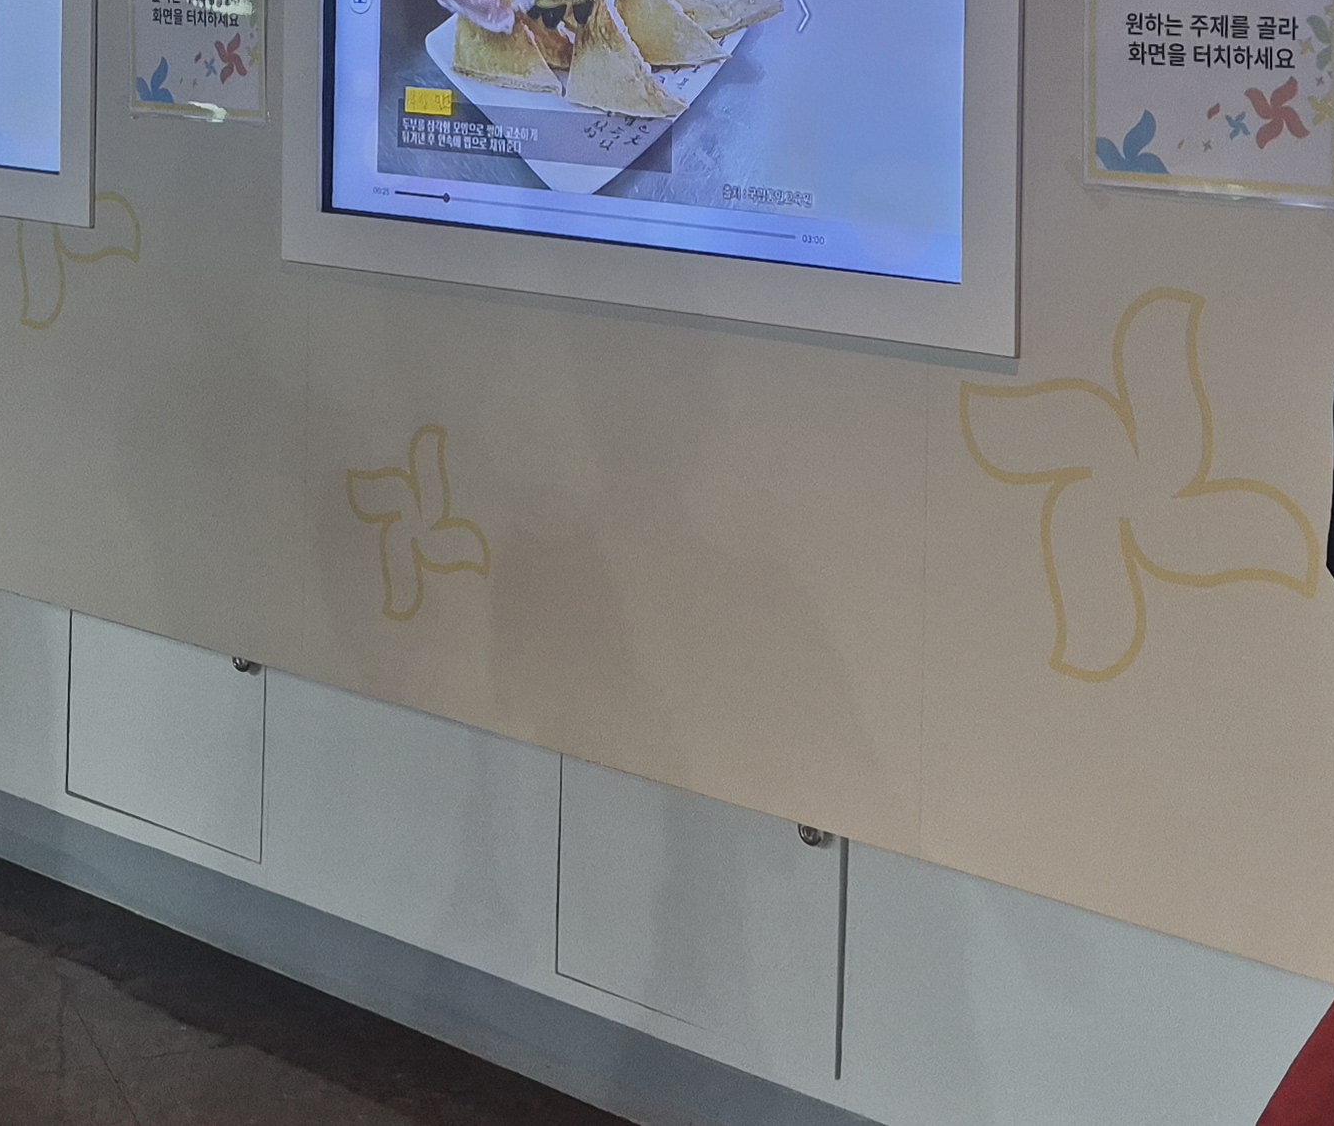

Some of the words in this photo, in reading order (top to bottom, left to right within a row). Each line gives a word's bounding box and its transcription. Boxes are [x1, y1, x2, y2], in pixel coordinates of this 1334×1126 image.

[152, 7, 183, 26] 화면을
[186, 10, 240, 28] 터치하세요
[1125, 12, 1184, 37] 원하는
[1189, 14, 1251, 40] 주제를
[1256, 16, 1299, 41] 골라
[1128, 41, 1187, 67] 화면을
[1193, 43, 1296, 71] 터치하세요
